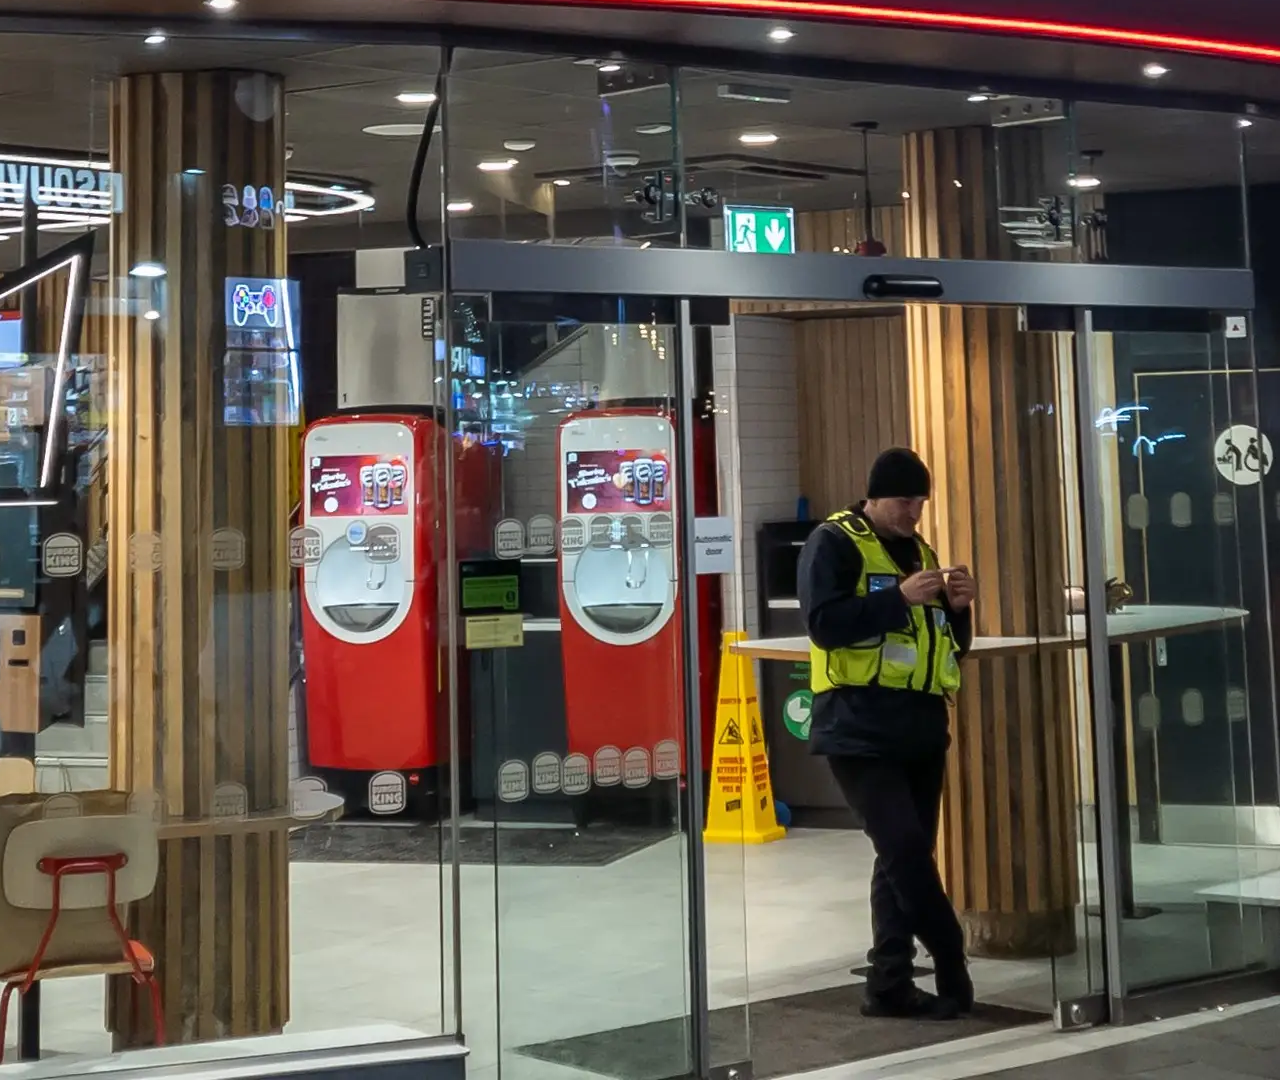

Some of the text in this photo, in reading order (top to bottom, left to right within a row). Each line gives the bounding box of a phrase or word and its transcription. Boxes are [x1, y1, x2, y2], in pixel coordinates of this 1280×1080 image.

[530, 536, 554, 545] KING
[561, 536, 584, 545] KING
[289, 547, 320, 557] KING
[46, 556, 79, 567] KING
[372, 793, 402, 805] KING
